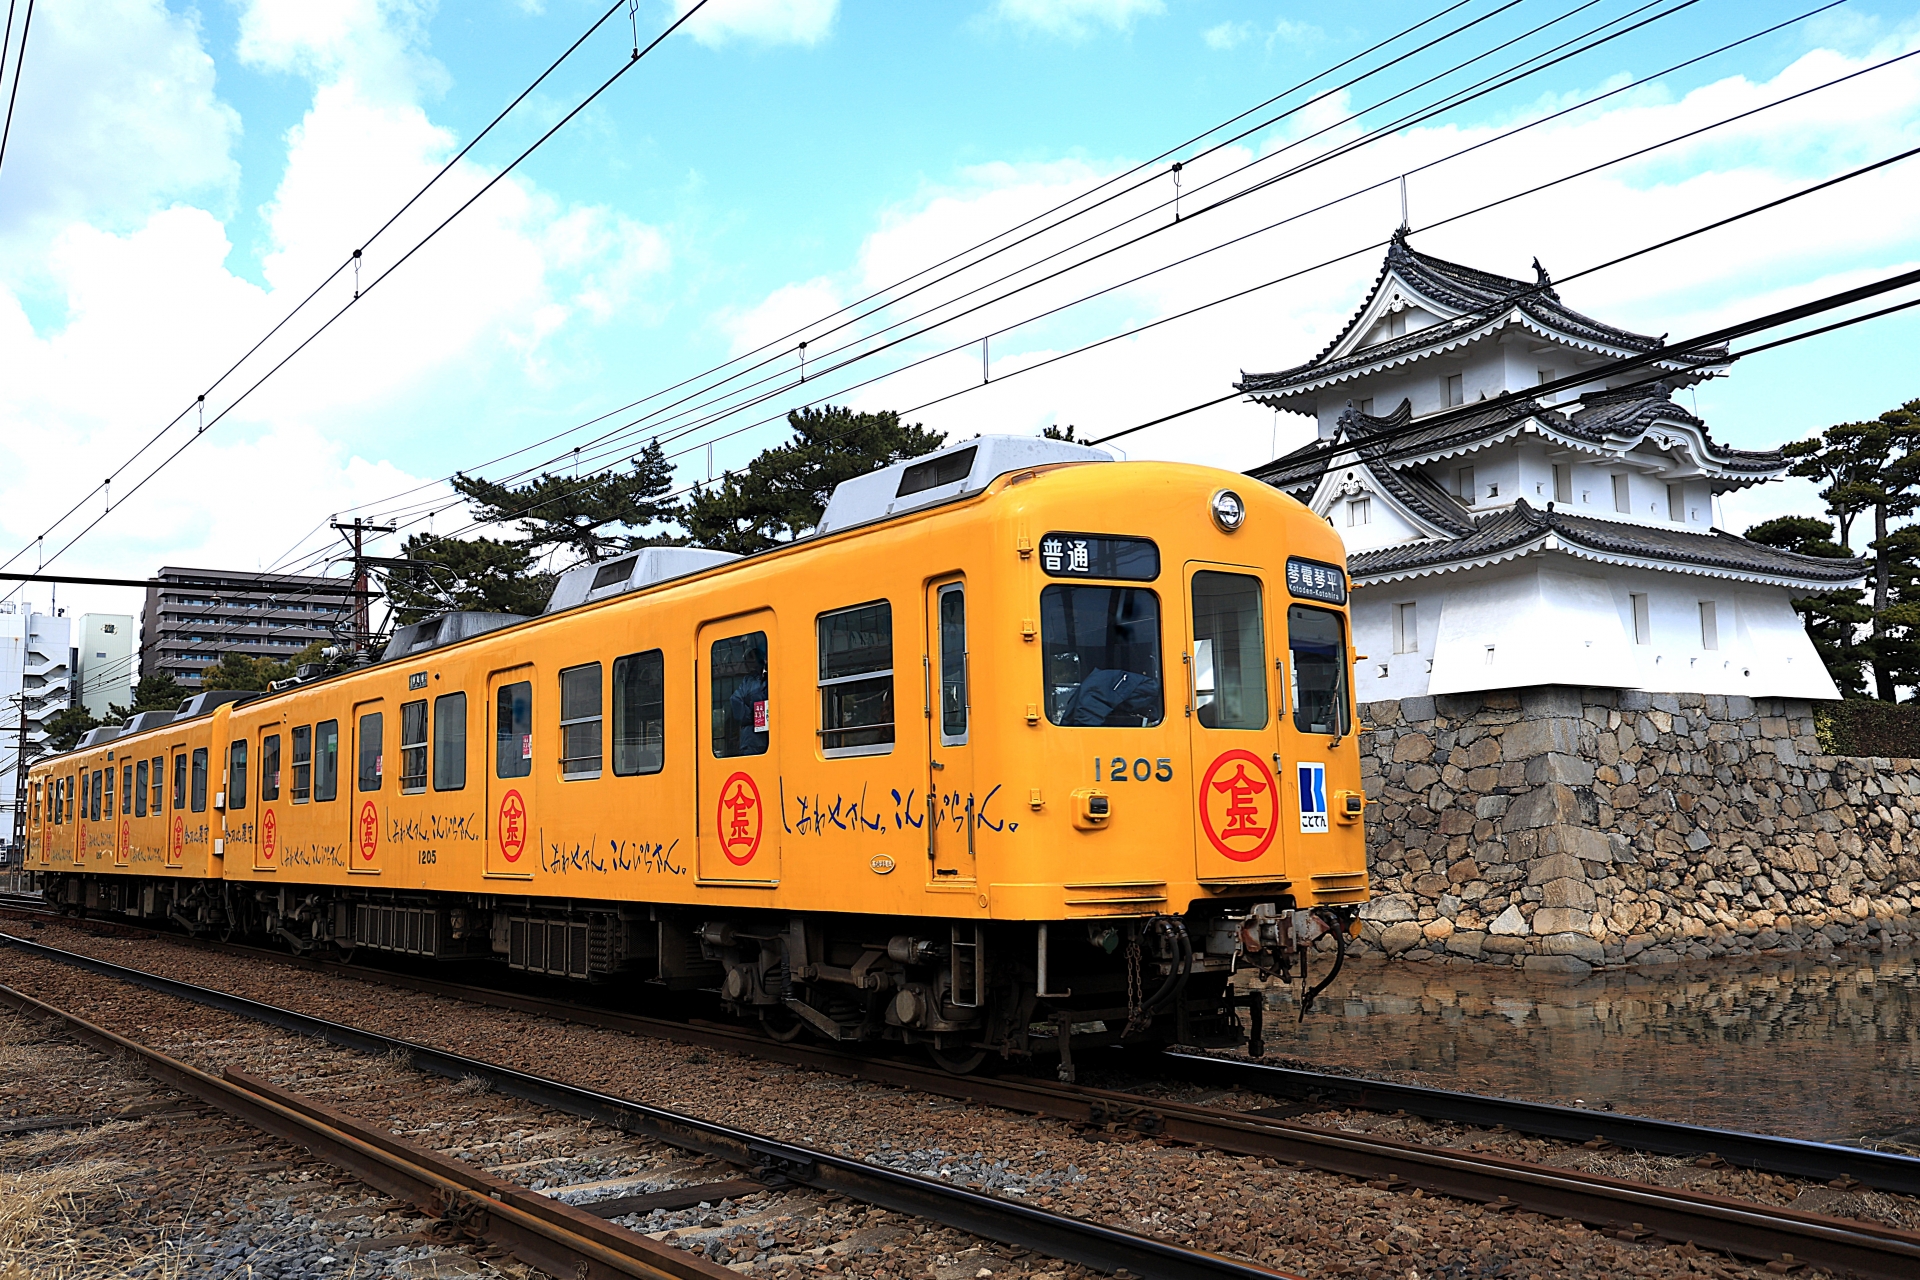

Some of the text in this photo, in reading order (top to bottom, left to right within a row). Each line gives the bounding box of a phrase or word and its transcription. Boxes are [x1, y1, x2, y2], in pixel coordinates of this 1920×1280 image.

[1042, 538, 1089, 572] 普通
[1287, 562, 1338, 592] 琴電琴平
[1288, 583, 1339, 600] Kotoden-Kotohira
[1094, 757, 1174, 783] 1205
[722, 781, 757, 849] 金
[1210, 762, 1269, 842] 金
[502, 797, 524, 850] 金
[418, 850, 437, 865] 1205
